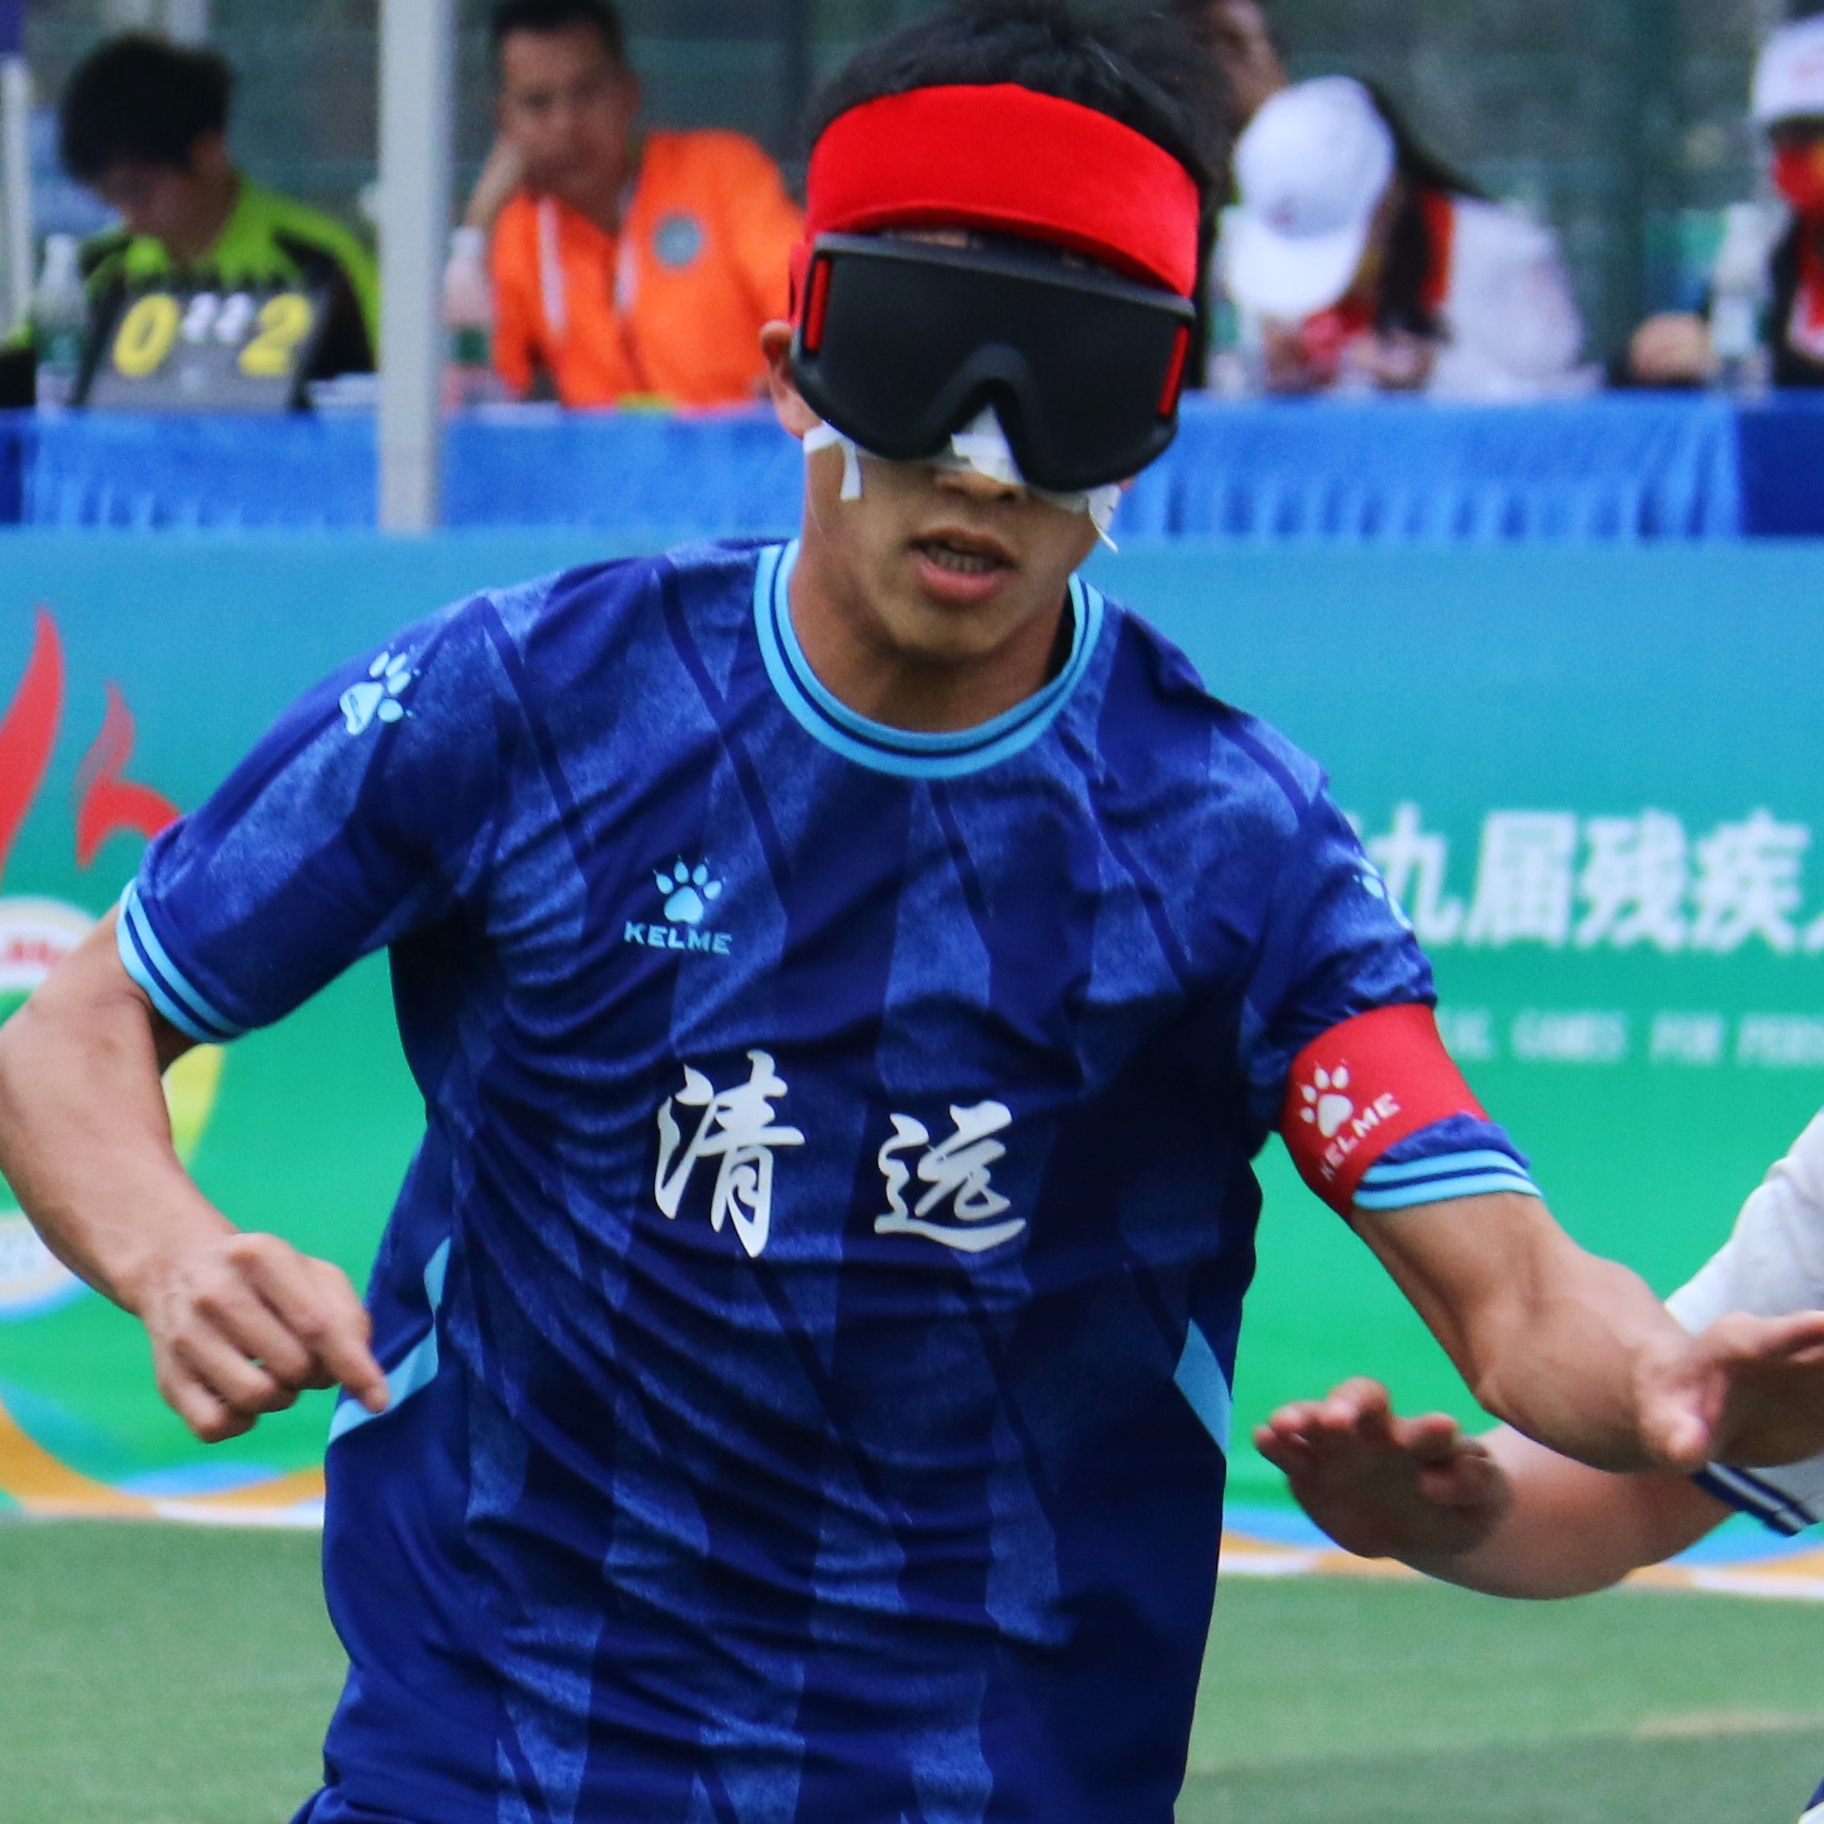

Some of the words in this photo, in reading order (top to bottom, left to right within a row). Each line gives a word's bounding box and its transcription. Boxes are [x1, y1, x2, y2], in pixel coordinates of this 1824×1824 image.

[113, 294, 177, 377] 0
[239, 294, 313, 376] 2
[624, 920, 732, 956] KELME
[654, 1048, 1028, 1258] 清远
[1319, 1092, 1402, 1183] KELME
